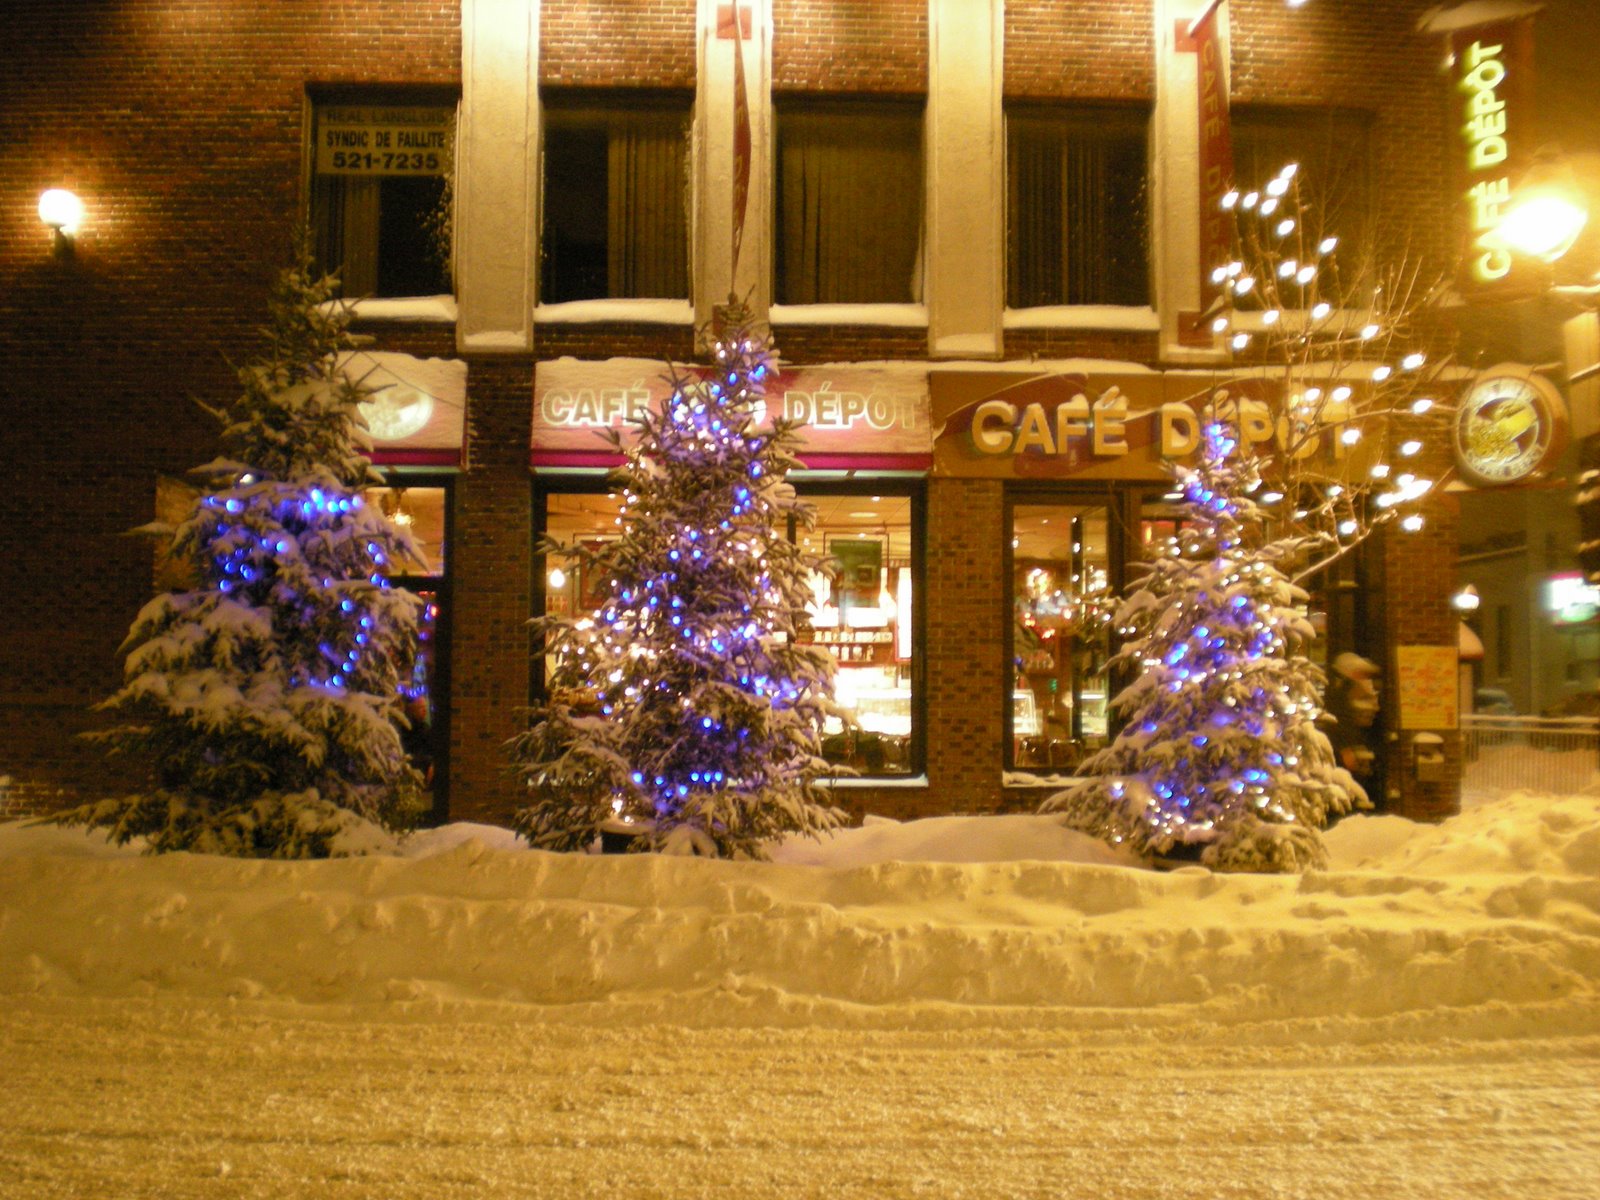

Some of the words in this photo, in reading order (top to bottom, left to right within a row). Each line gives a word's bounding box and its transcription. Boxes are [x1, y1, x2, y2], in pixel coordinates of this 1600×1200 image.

[326, 131, 369, 147] SYNDIC
[375, 131, 391, 147] DE
[397, 131, 445, 148] FAILLITE
[332, 151, 439, 170] 521-7235
[542, 379, 651, 427] CAFÉ
[971, 385, 1129, 456] CAFÉ
